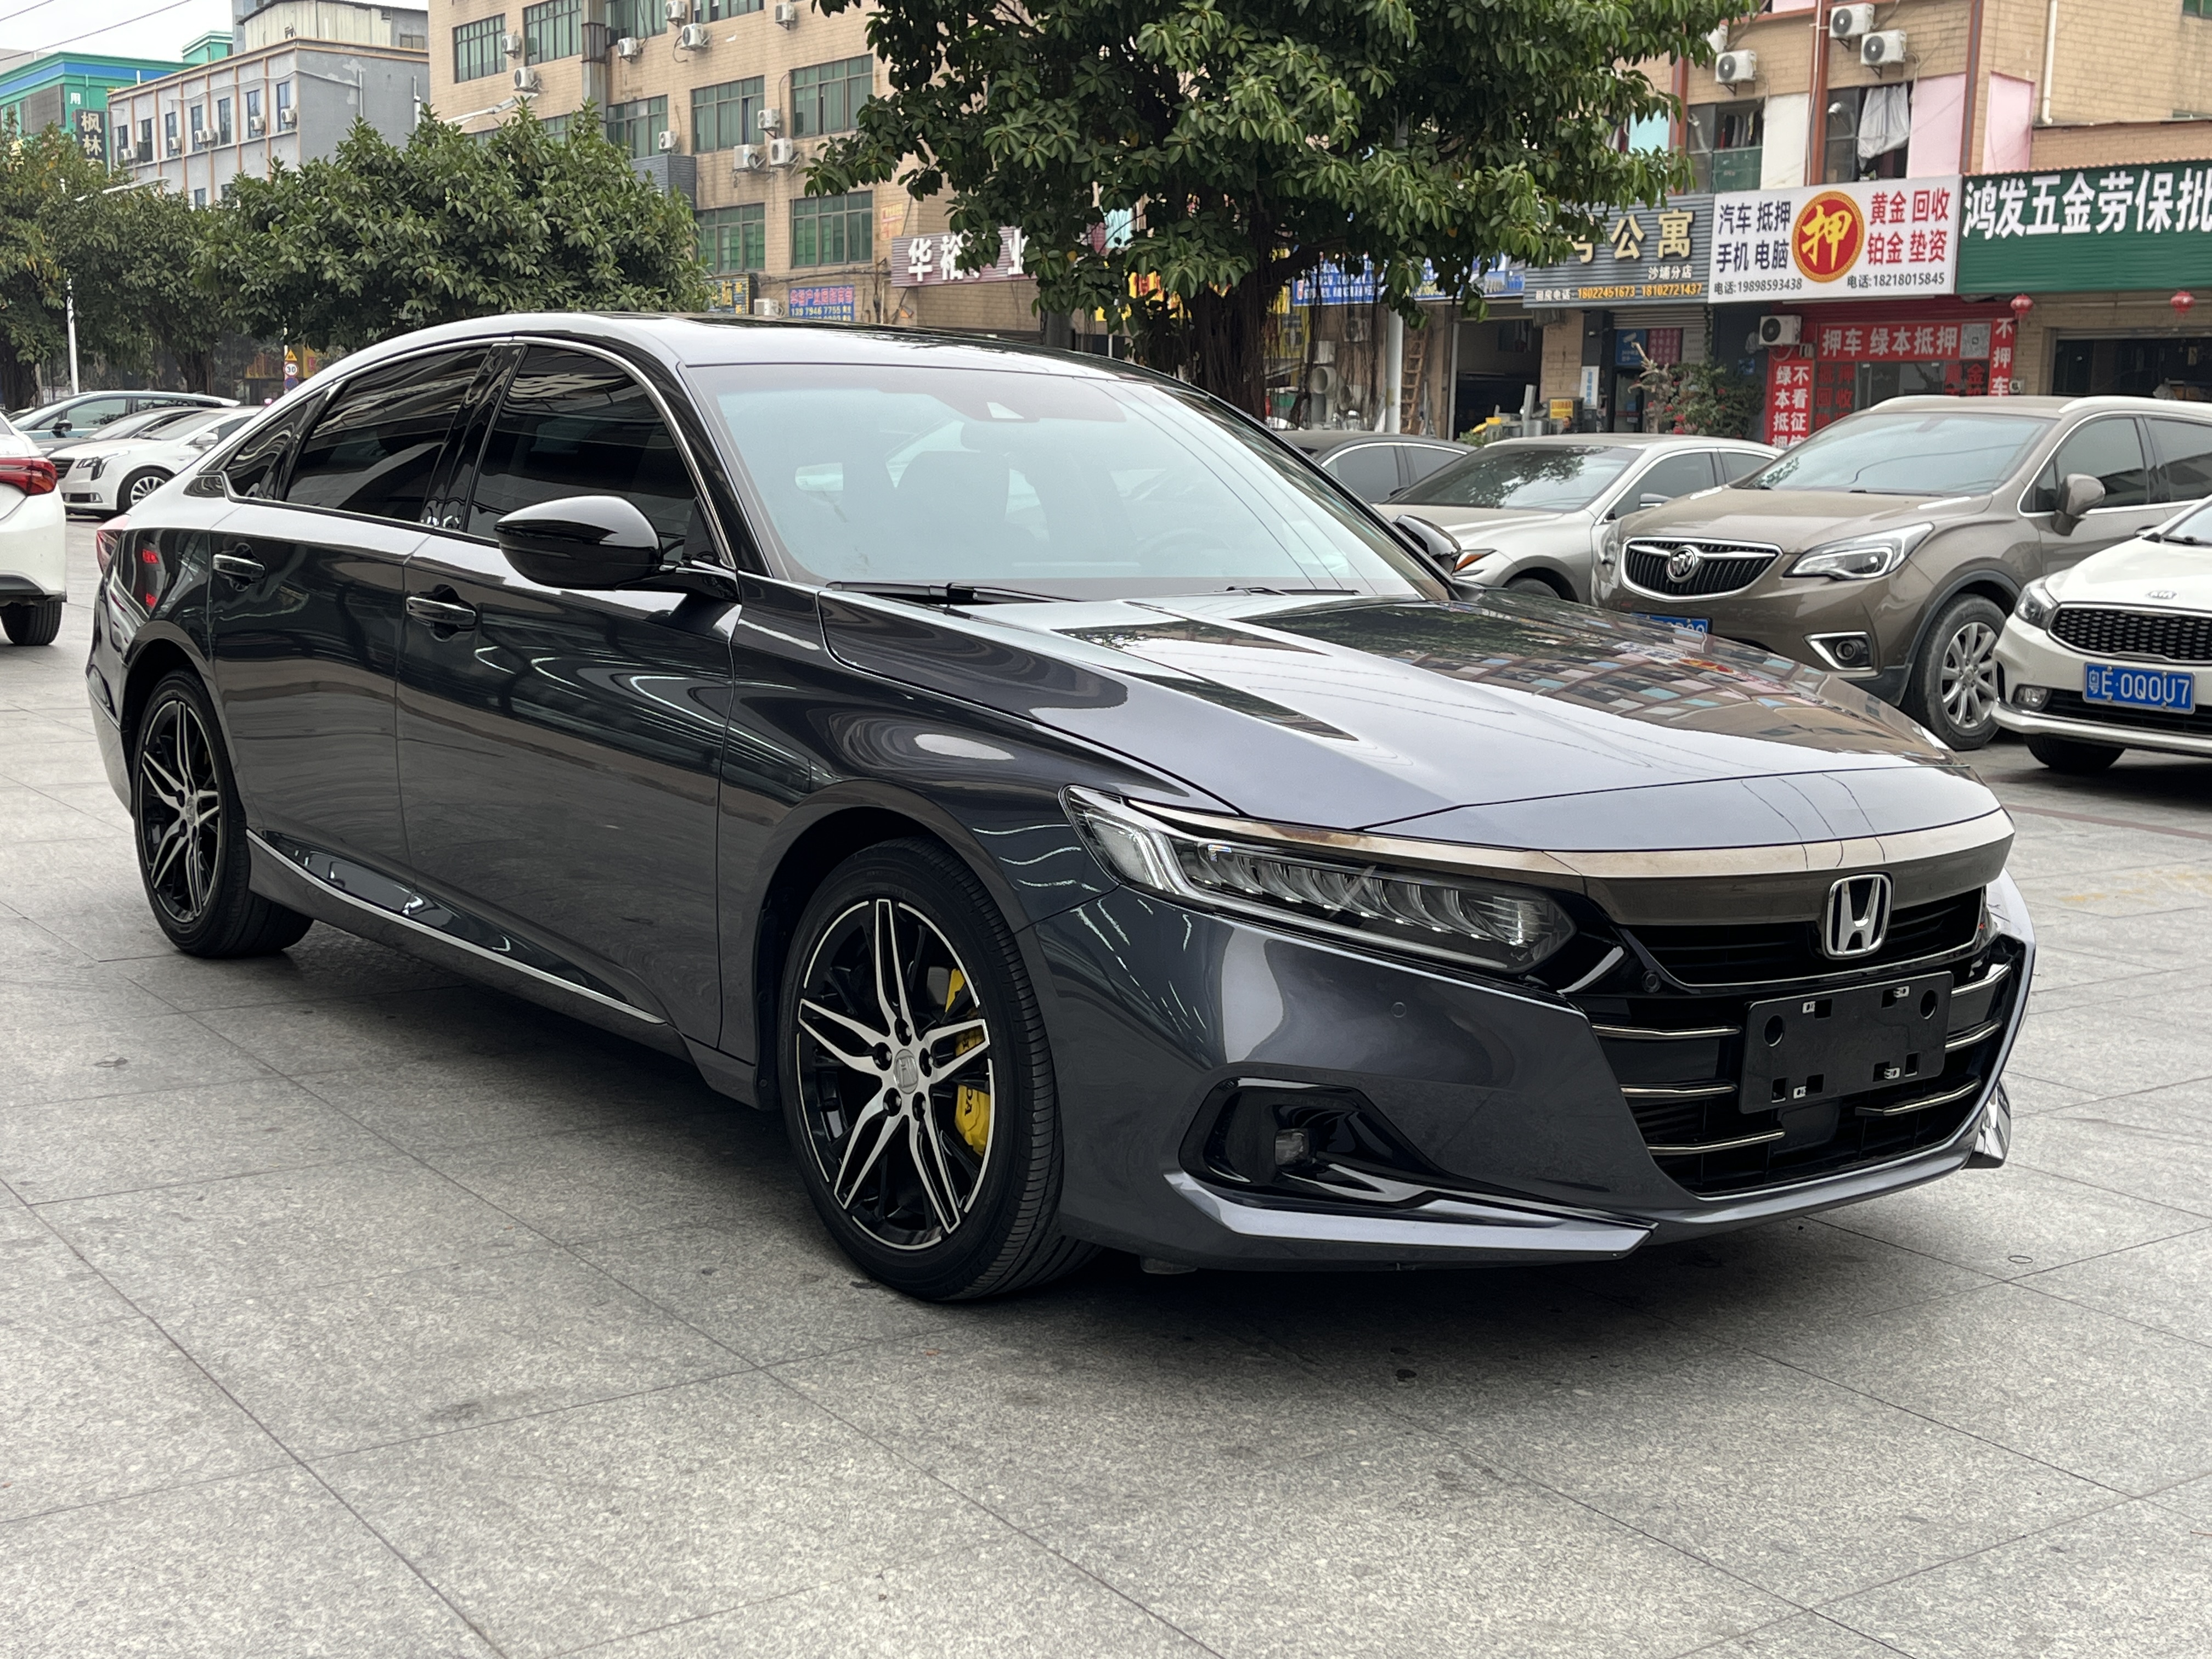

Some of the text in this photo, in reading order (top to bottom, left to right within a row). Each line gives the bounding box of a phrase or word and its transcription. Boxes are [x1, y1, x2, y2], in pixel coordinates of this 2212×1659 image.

[1718, 200, 1791, 235] 汽车 抵押
[1870, 187, 1950, 225] 黄金 回收
[1963, 167, 2212, 240] 鸿发五金劳保批
[1716, 238, 1790, 273] 手机 电脑
[1802, 205, 1852, 270] 押
[1867, 228, 1947, 266] 铂金 垫资
[1822, 326, 1958, 357] 押车 绿本抵押
